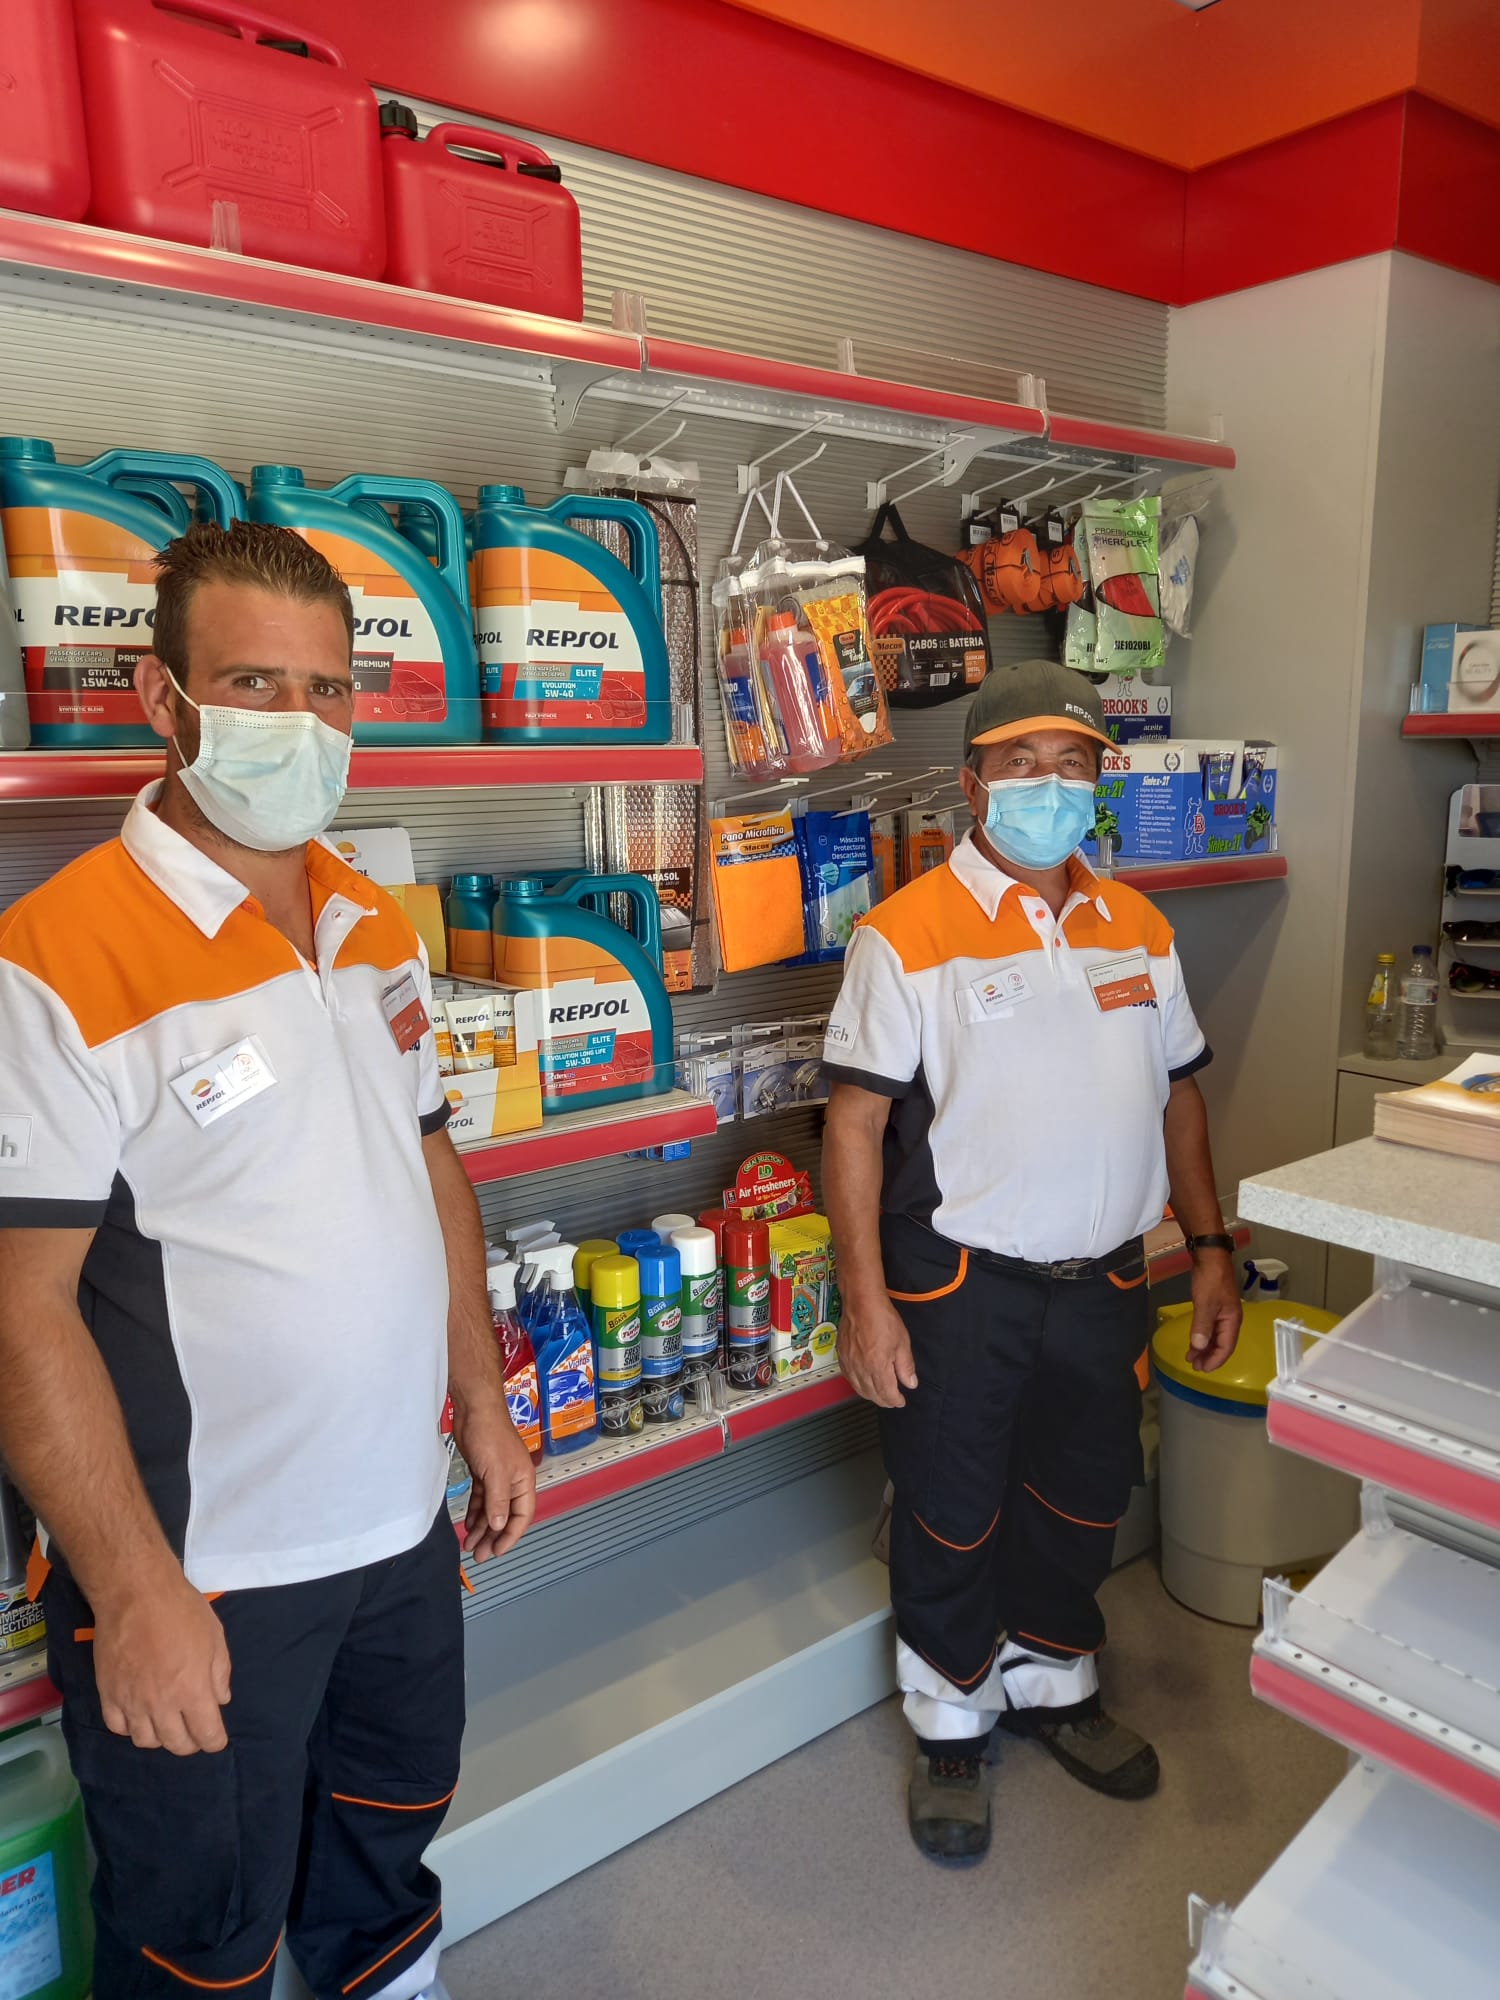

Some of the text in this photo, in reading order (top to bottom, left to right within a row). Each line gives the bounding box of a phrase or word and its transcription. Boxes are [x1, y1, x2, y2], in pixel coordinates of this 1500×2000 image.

[54, 605, 155, 628] REPS
[353, 617, 412, 638] SOL
[526, 628, 619, 649] REPSOL
[909, 636, 985, 650] CABOS DE BATERIA
[117, 654, 143, 663] PREM
[352, 660, 390, 668] PREMIUM
[575, 669, 597, 678] ELITE
[80, 677, 129, 688] 15W-40
[541, 682, 577, 690] EVOLUTION
[544, 689, 574, 698] 5W-40
[1102, 698, 1148, 715] BROOK'S
[1102, 756, 1131, 771] OK'S
[1095, 780, 1126, 799] ex-2T
[721, 827, 785, 843] Pano Microfibra
[833, 843, 867, 852] Protectoras
[549, 998, 630, 1024] REPSOL
[455, 1014, 490, 1024] REPSOL
[592, 1035, 612, 1045] ELITE
[826, 1026, 849, 1043] ech
[547, 1051, 579, 1061] EVOLUTION
[579, 1050, 594, 1058] LONG
[565, 1057, 591, 1068] 5W-30
[195, 1089, 226, 1111] REPSOL
[446, 1117, 475, 1129] PSOL
[758, 1165, 773, 1179] LD
[738, 1186, 752, 1199] Air
[753, 1178, 796, 1195] Fresheners
[705, 1293, 717, 1305] Tur
[622, 1325, 640, 1338] Turtl
[0, 1608, 45, 1636] JECTORES
[0, 1866, 36, 1897] ER
